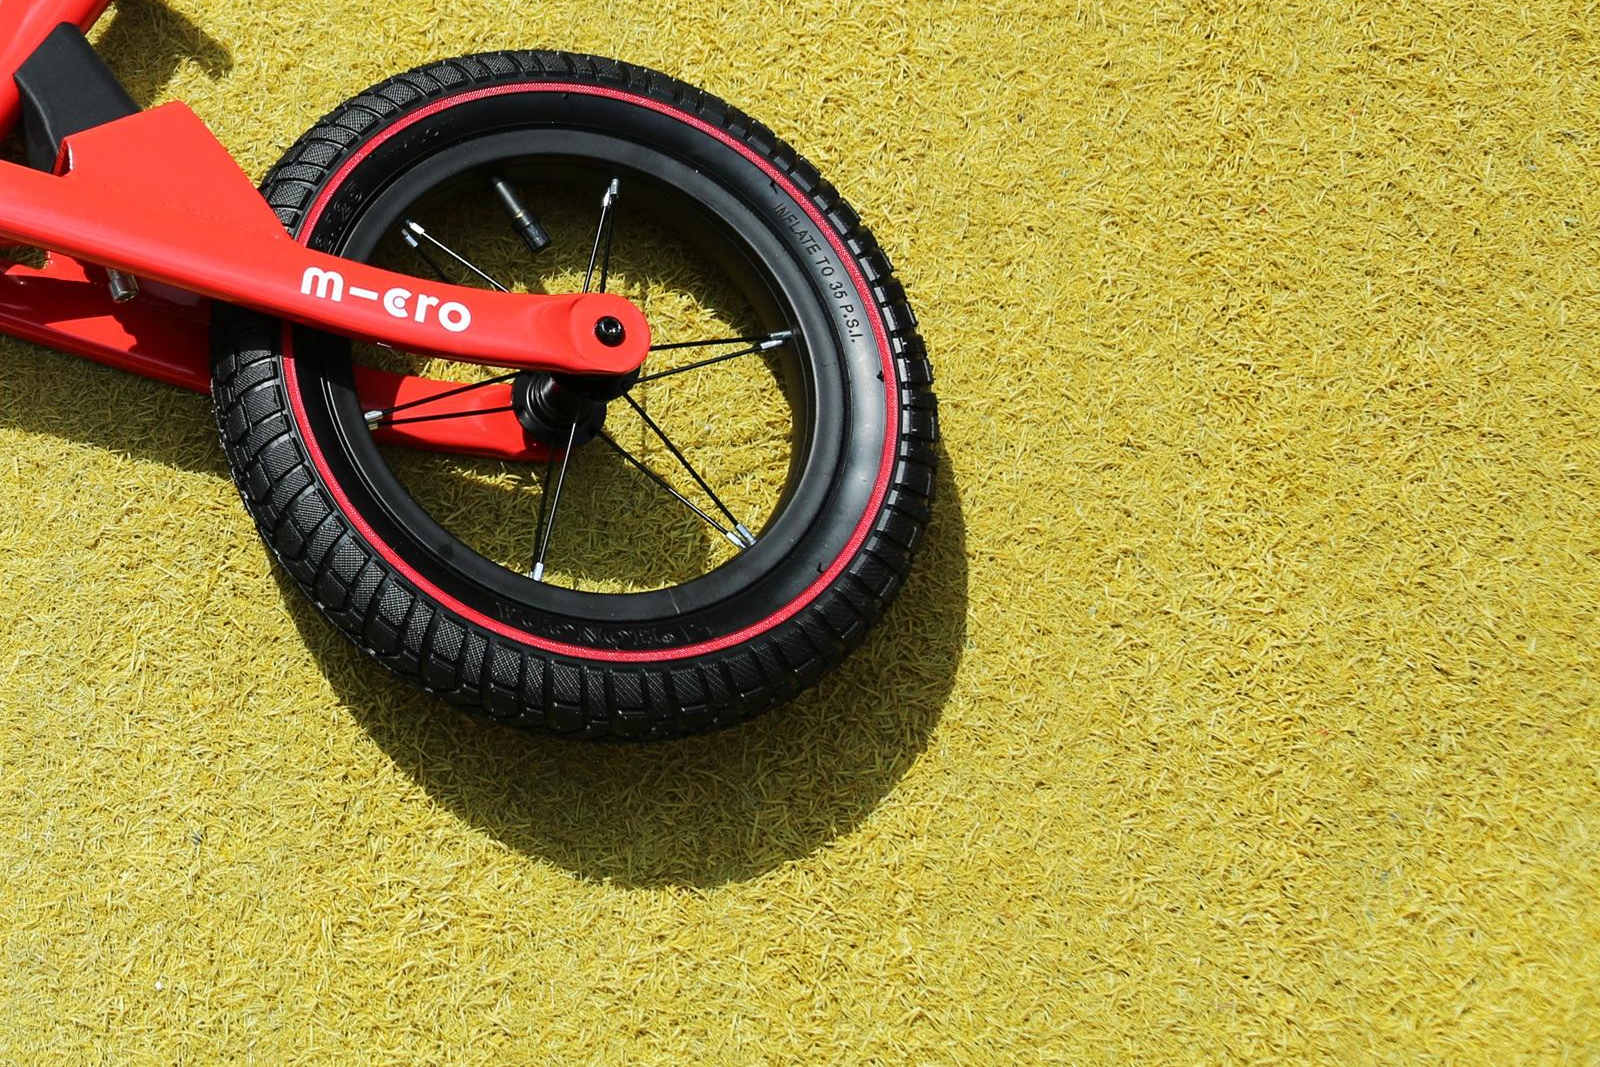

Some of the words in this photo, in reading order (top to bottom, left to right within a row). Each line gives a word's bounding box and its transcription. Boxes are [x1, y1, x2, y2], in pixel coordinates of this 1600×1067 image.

[774, 202, 822, 256] INFLATE
[815, 256, 835, 277] TO
[829, 281, 848, 300] 35
[839, 304, 863, 343] P.S.I.
